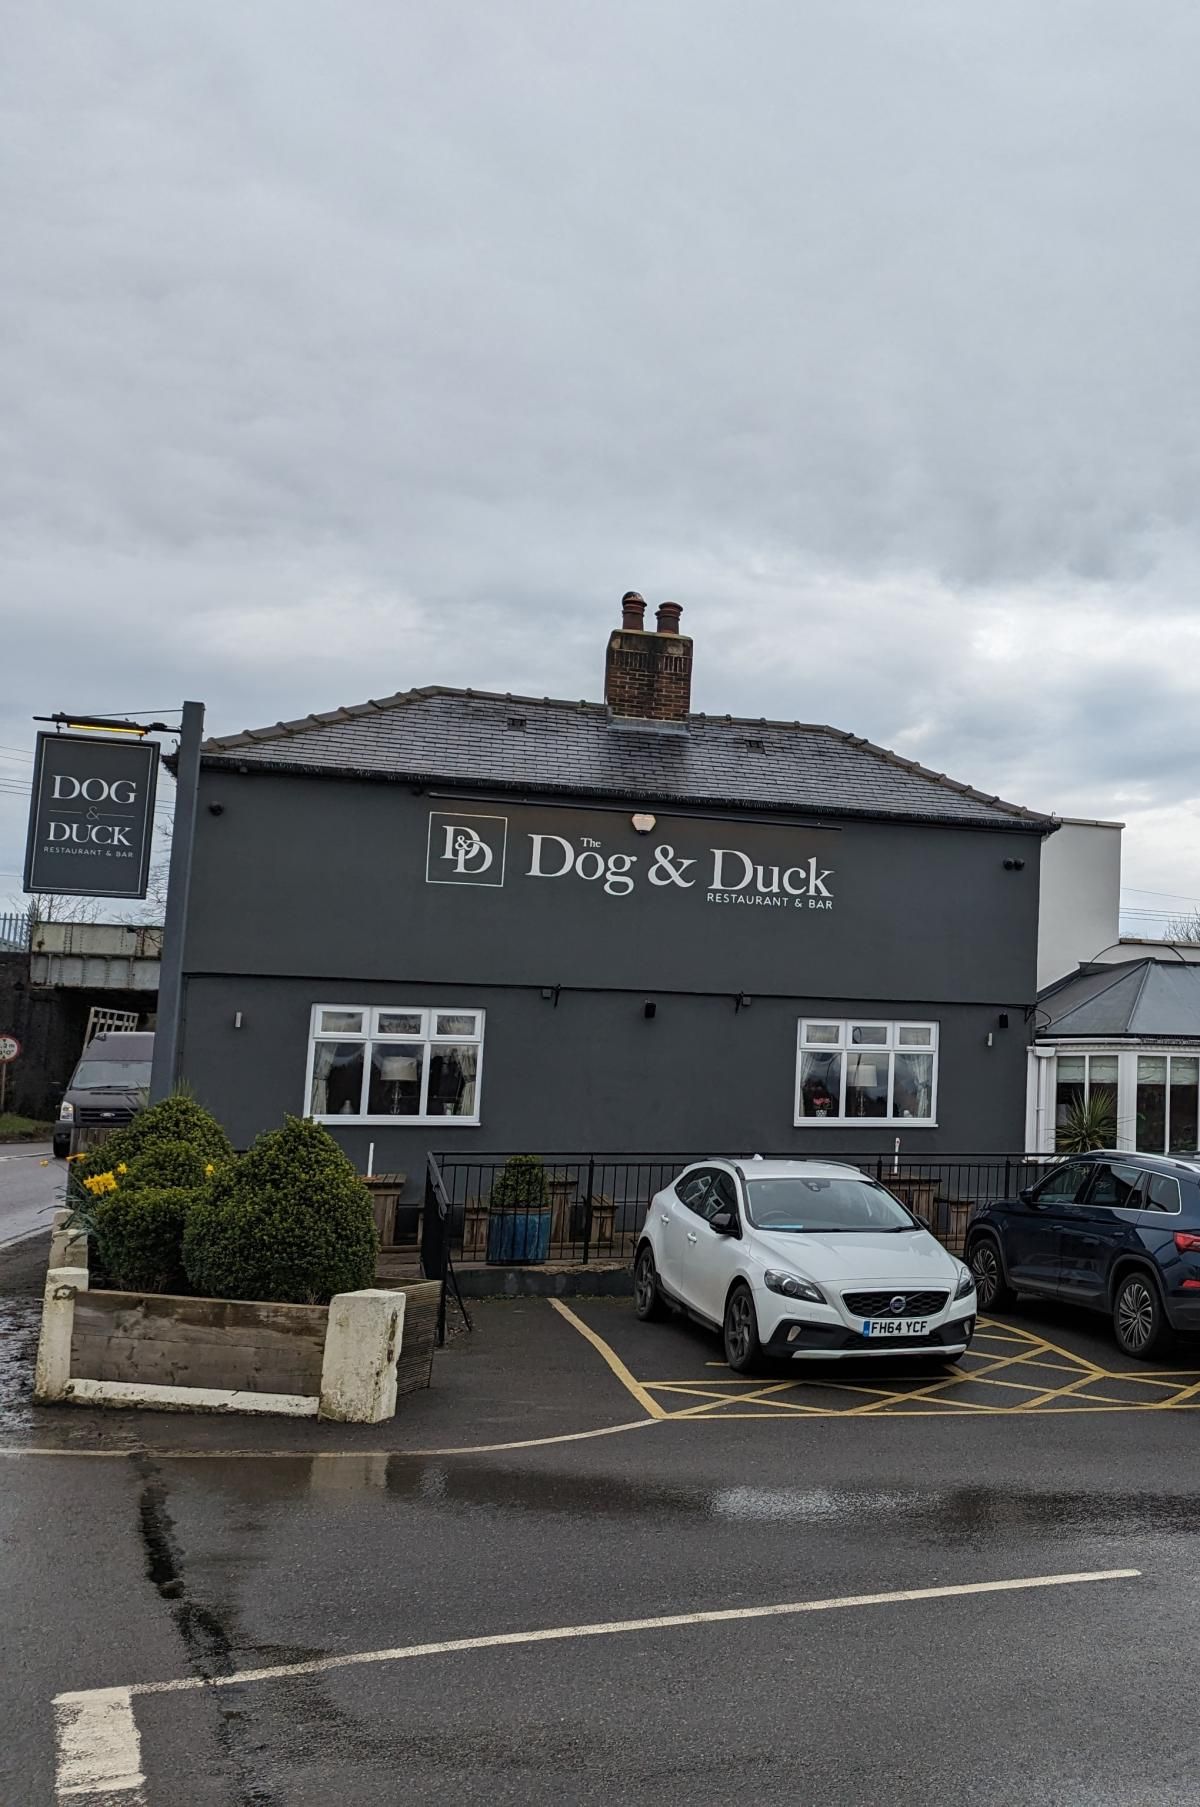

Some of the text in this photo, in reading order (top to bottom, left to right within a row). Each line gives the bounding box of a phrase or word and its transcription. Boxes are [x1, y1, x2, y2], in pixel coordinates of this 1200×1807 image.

[51, 774, 138, 804] DOG
[86, 805, 100, 820] &
[47, 821, 133, 846] DUCK
[580, 837, 601, 848] The
[43, 846, 102, 856] RESTAURANT
[115, 850, 134, 858] BAR
[525, 834, 835, 898] Dog & Duck
[706, 892, 833, 910] RESTAURANT & BAR
[871, 1321, 928, 1334] FH64 YCF
